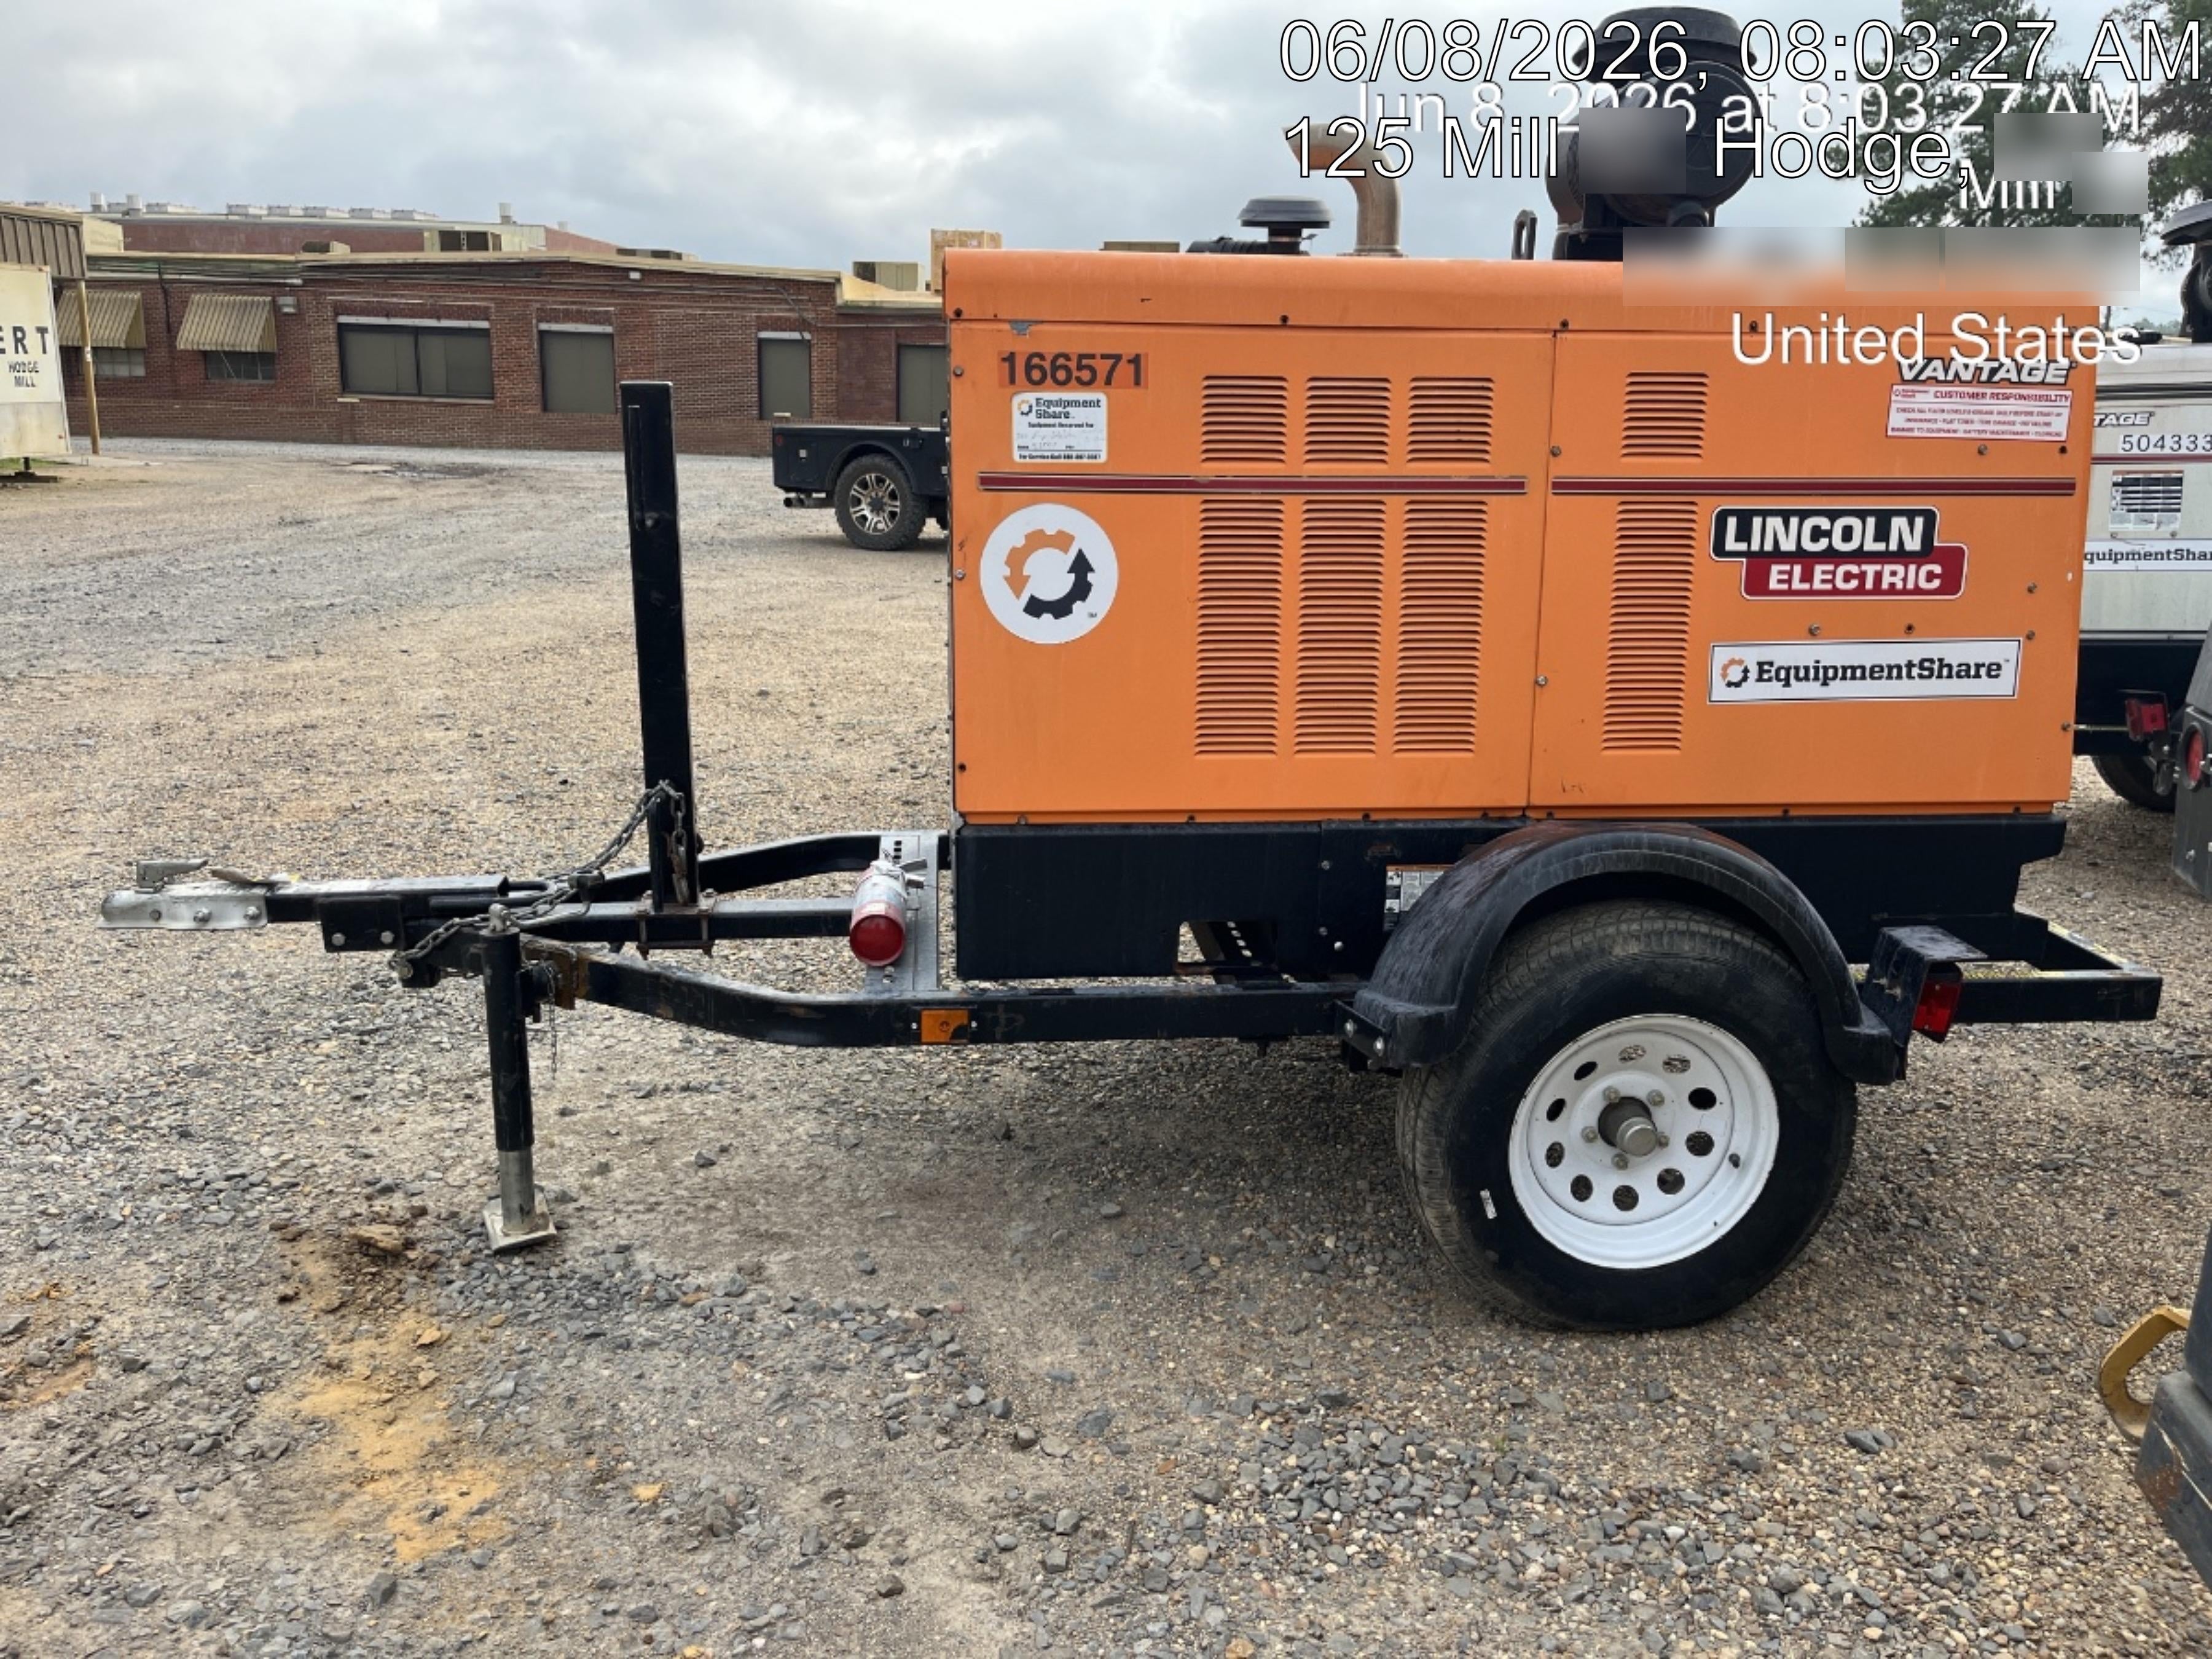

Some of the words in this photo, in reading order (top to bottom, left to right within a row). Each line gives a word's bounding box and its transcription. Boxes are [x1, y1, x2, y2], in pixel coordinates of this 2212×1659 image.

[1001, 351, 1142, 386] 166571
[1897, 358, 2069, 385] VANTAGE
[1035, 397, 1102, 410] Equipment
[1933, 389, 1988, 401] CUSTOMER
[2122, 434, 2212, 452] 504333
[1725, 516, 1925, 552] LINCOLN
[1768, 563, 1942, 591] ELECTRIC
[1755, 657, 2003, 688] EquipmentShare
